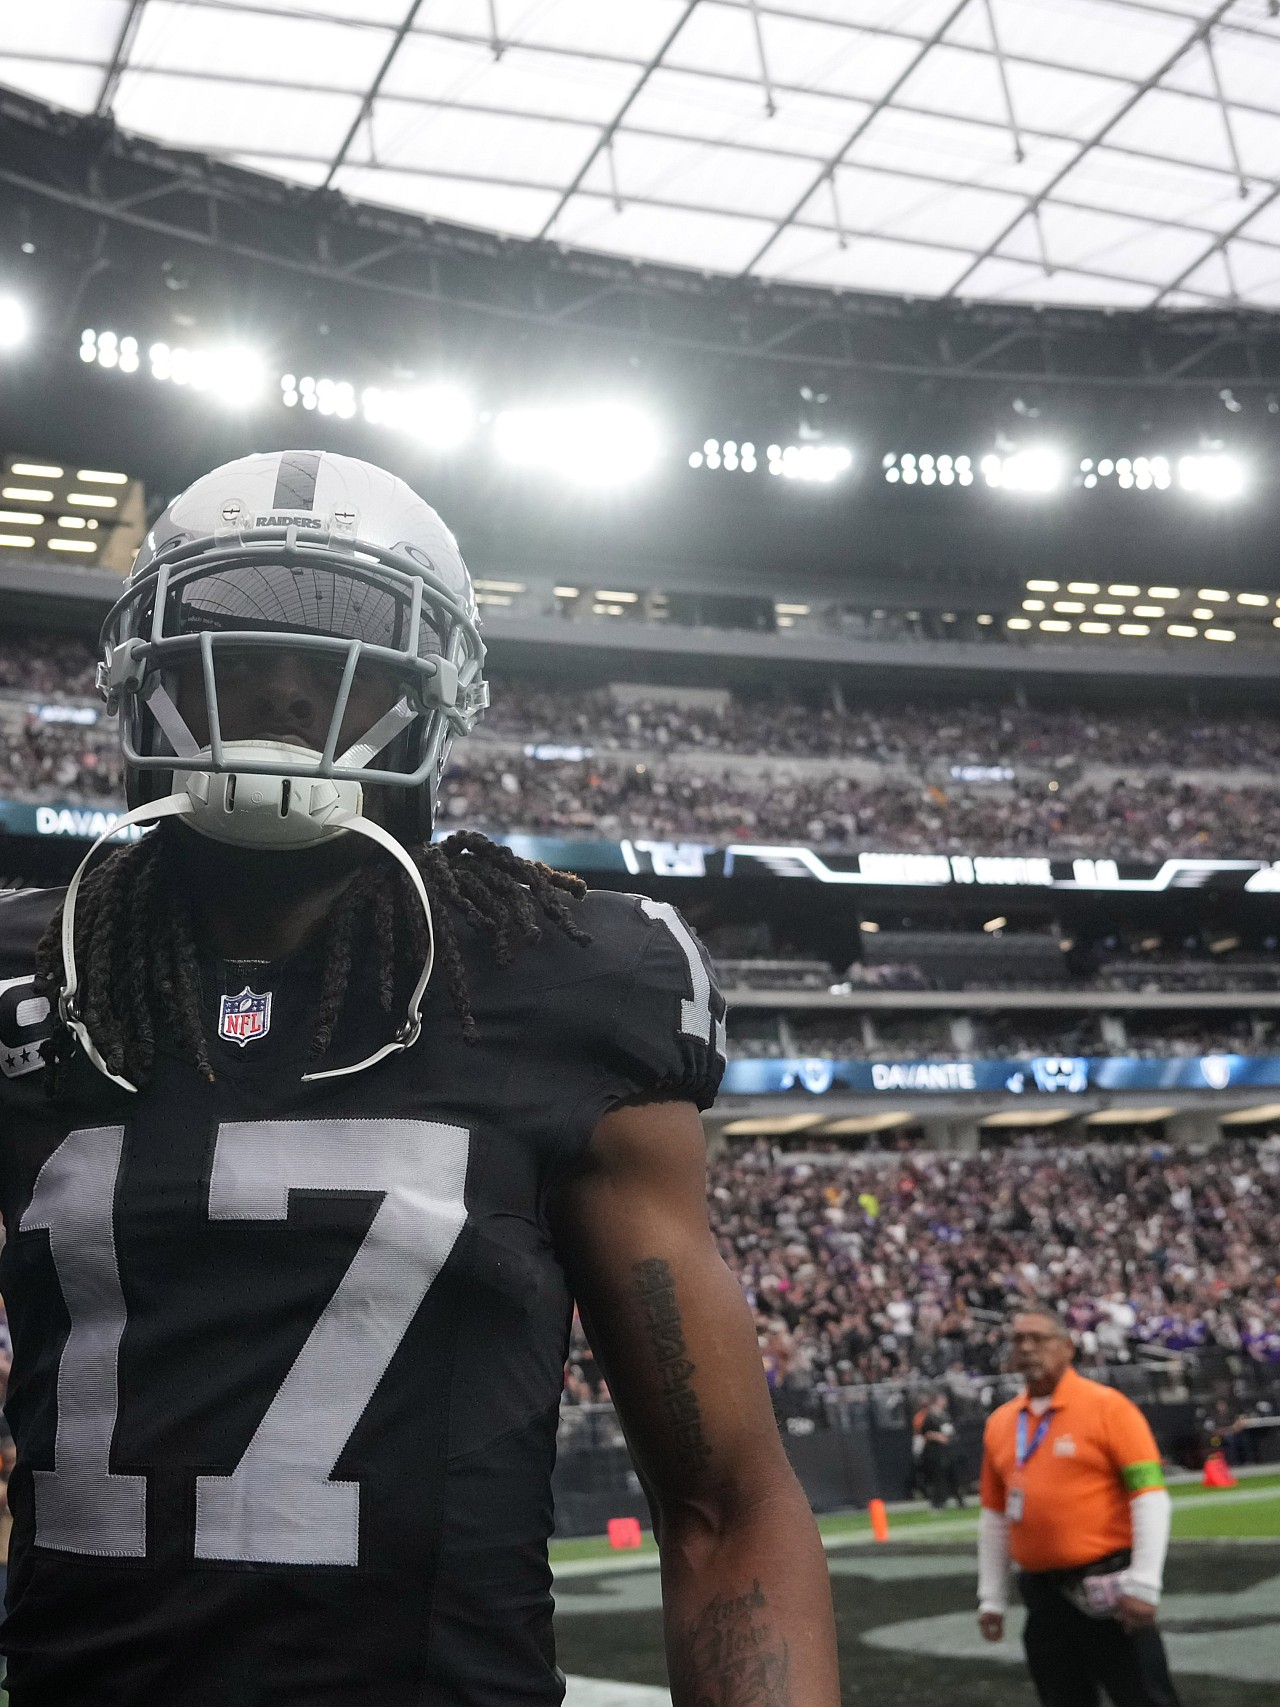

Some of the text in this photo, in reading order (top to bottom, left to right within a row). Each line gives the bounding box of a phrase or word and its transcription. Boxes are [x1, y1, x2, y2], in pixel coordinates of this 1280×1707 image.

[255, 516, 322, 529] RAIDERS
[226, 1013, 261, 1036] NFL
[871, 1063, 975, 1090] DAVANTE
[20, 1118, 470, 1567] 17
